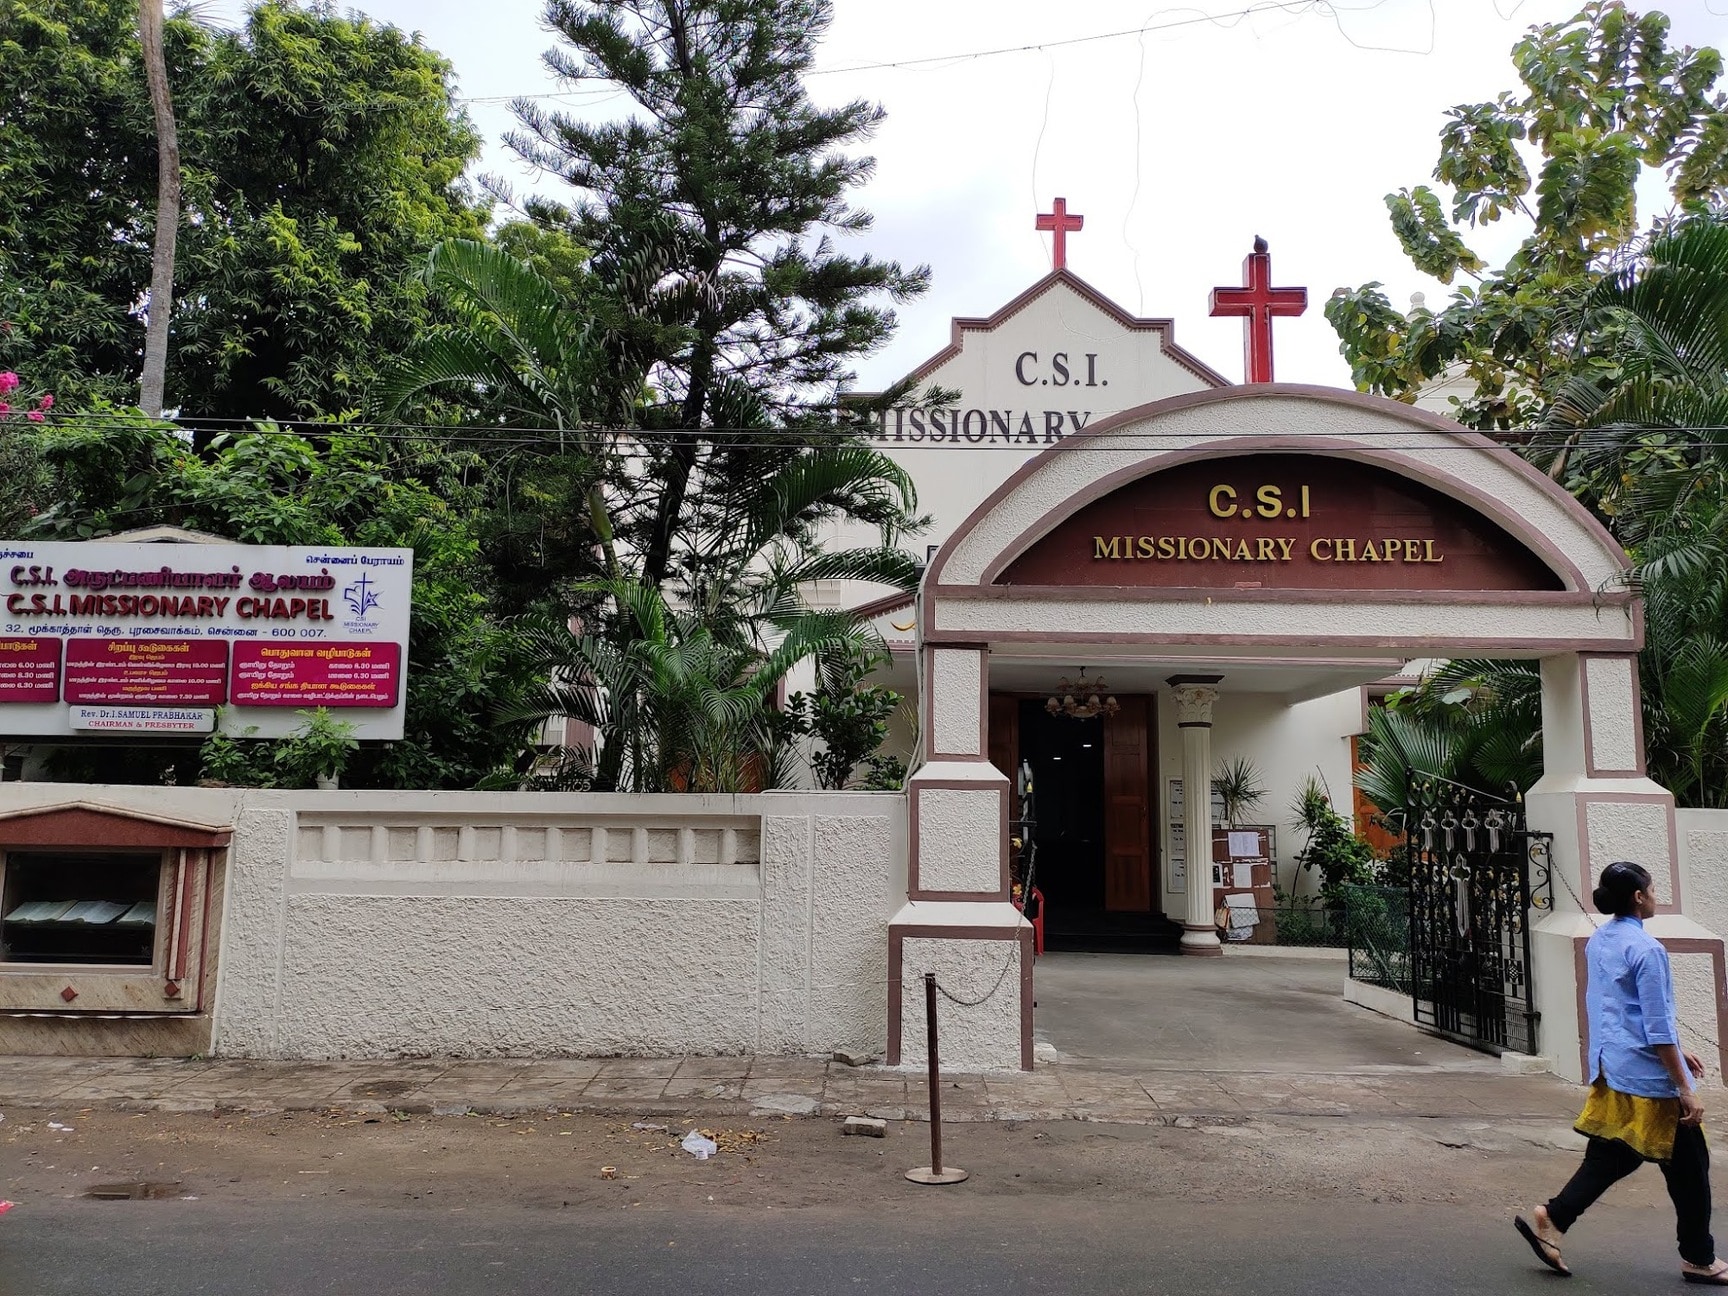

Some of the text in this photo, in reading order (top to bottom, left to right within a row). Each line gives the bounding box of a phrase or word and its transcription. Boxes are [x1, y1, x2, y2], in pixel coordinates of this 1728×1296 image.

[1016, 352, 1108, 387] C.S.I.
[1209, 485, 1309, 518] C.S.I
[1093, 536, 1444, 563] MISSIONARY CHAPEL
[306, 554, 404, 567] சென்னைப் பேராயம்
[10, 565, 58, 586] C.S.I.
[249, 567, 336, 592] ஆலயம்
[7, 593, 334, 620] C.S.I. MISSIONARY CHAPEL
[207, 626, 258, 636] சென்னை
[272, 628, 296, 637] 600
[0, 640, 37, 651] பாடுகள்
[108, 641, 136, 654] சிறப்பு
[261, 647, 371, 660] பொதுவான வழிபாடுகள்
[36, 661, 55, 669] மணி
[371, 662, 390, 670] மணி
[34, 681, 54, 689] மணி
[80, 710, 98, 718] Rev.
[152, 711, 203, 720] PRABHAKAR
[145, 721, 195, 729] PRESBYTER
